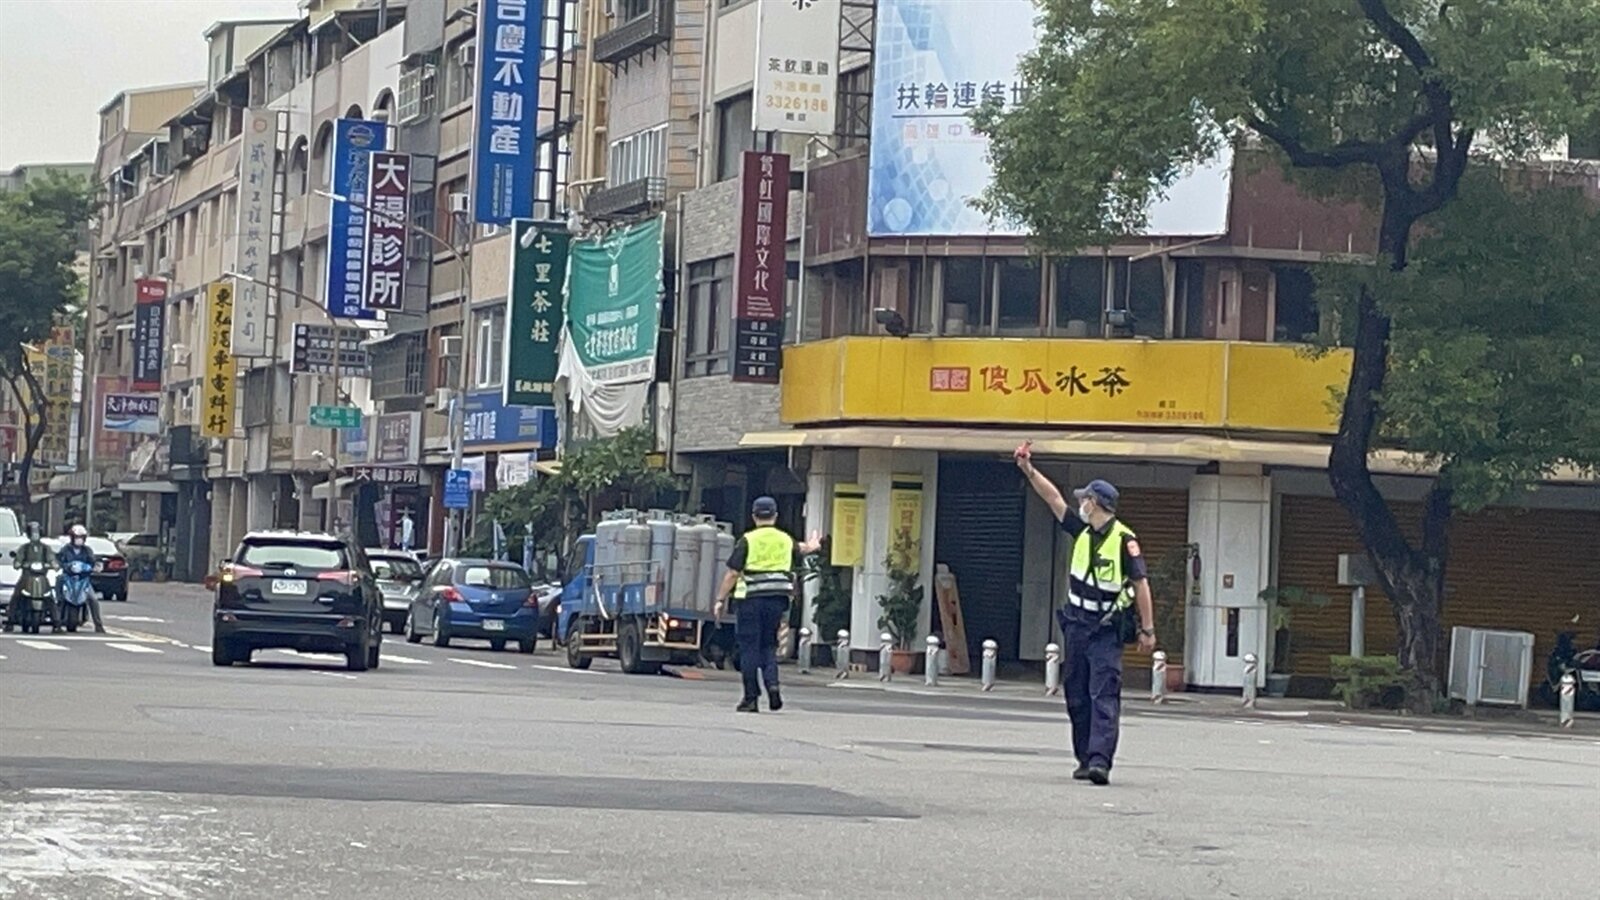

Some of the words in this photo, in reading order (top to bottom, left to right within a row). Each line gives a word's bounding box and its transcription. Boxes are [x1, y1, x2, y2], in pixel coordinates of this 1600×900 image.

[369, 157, 406, 305] 大福診所
[980, 365, 1131, 398] 傻瓜冰茶
